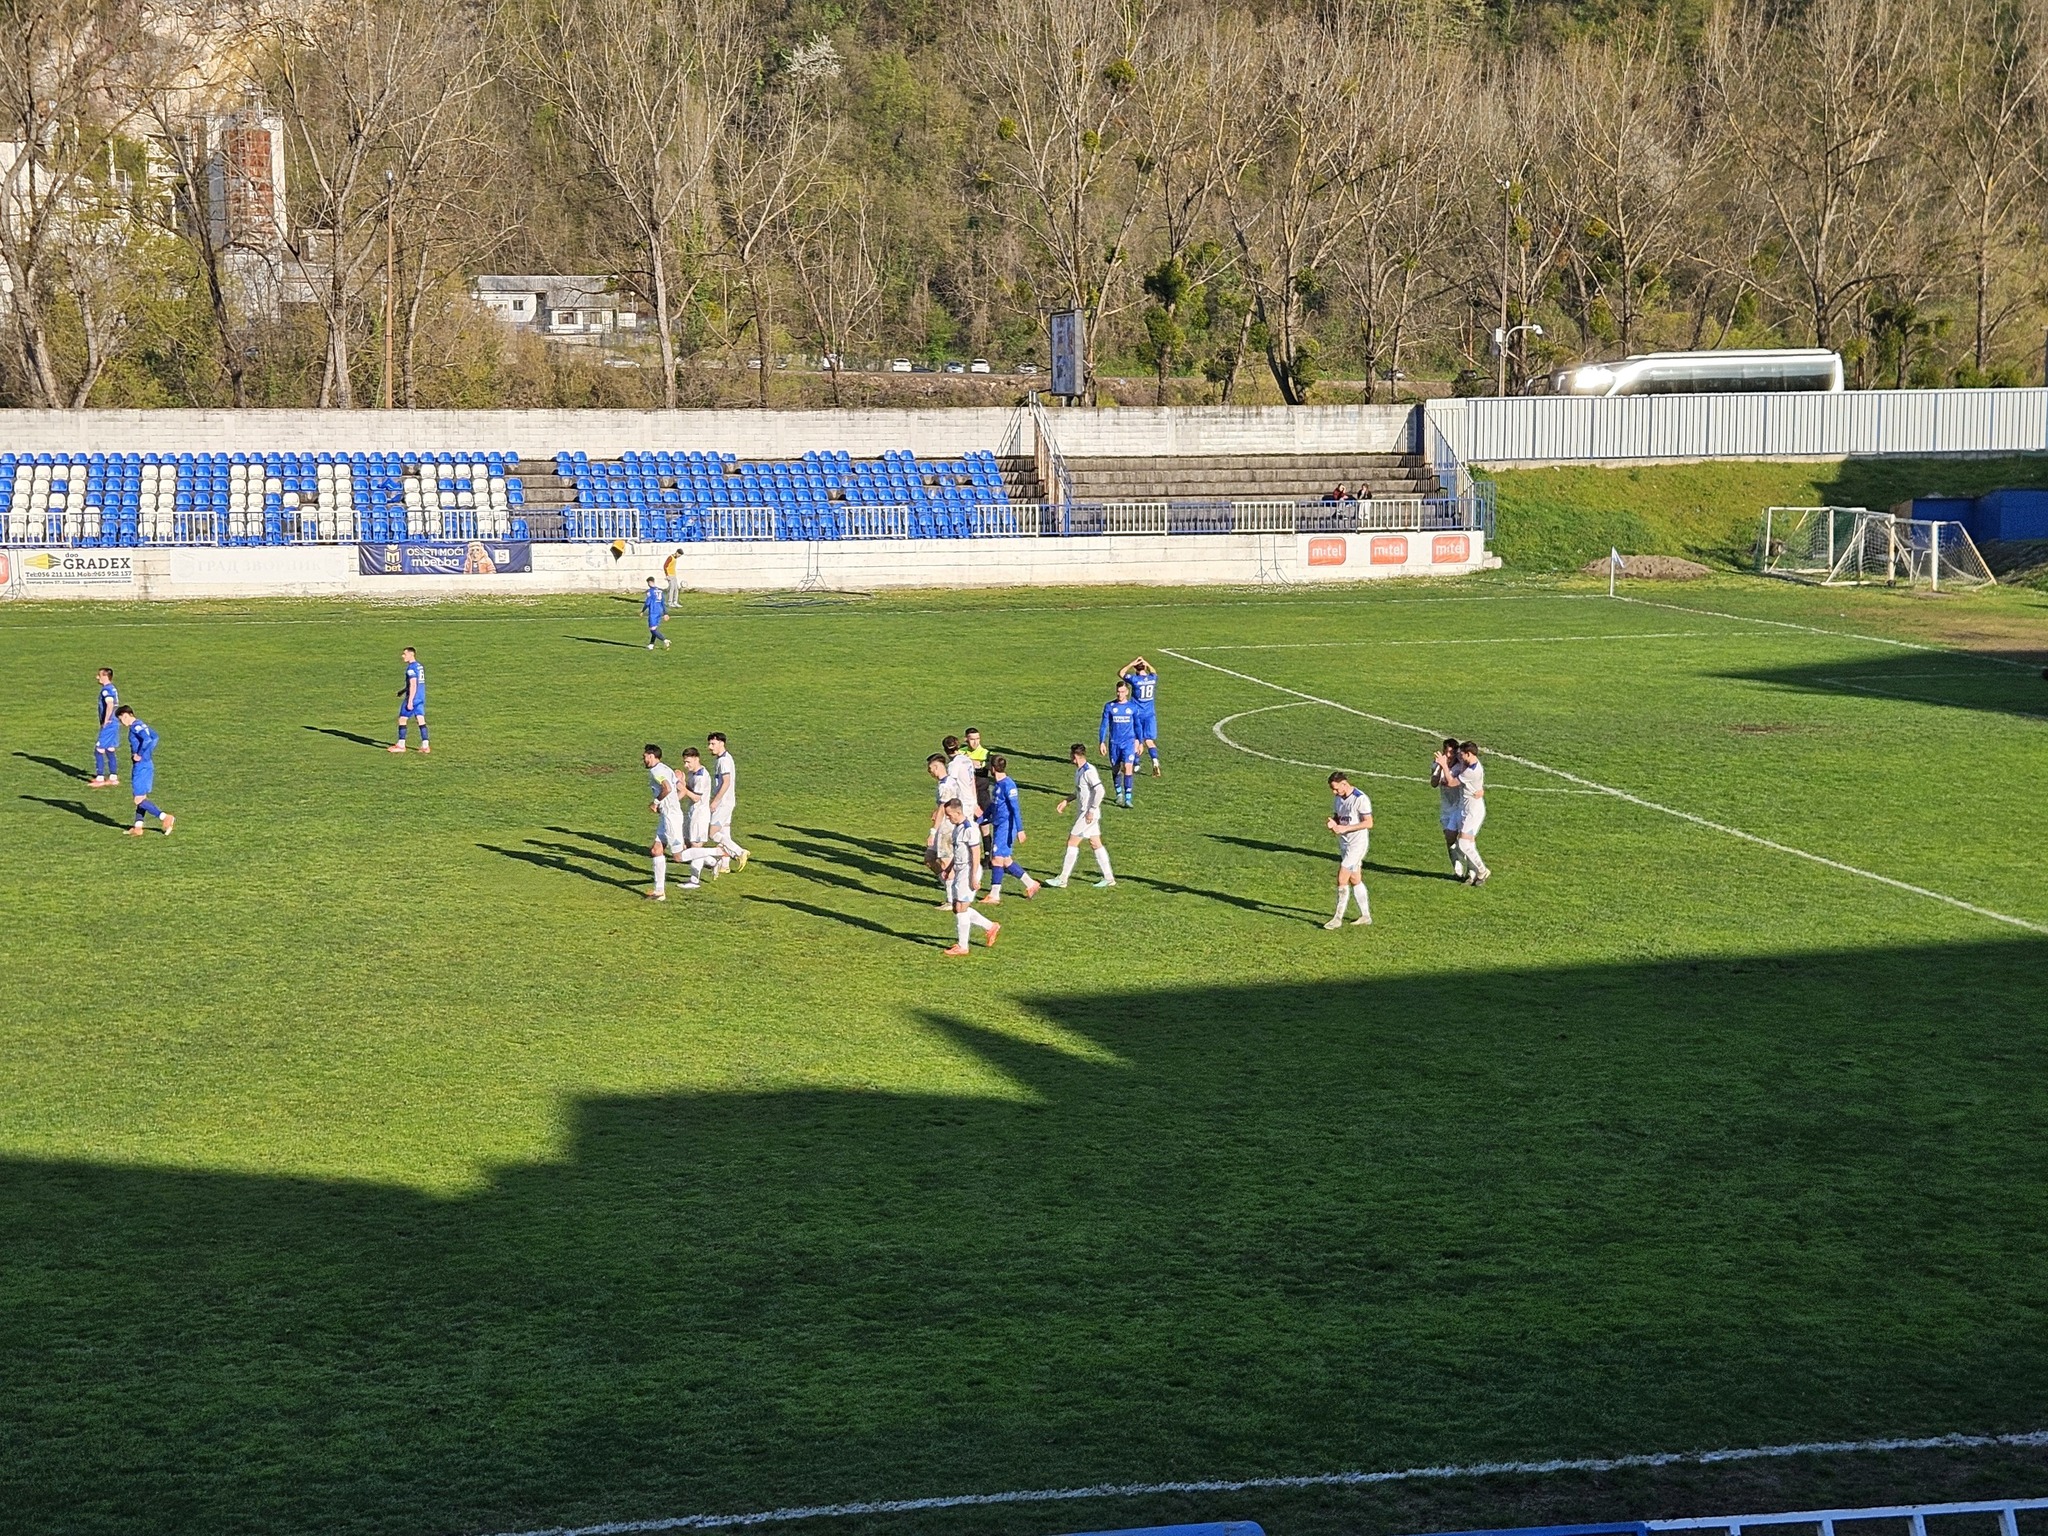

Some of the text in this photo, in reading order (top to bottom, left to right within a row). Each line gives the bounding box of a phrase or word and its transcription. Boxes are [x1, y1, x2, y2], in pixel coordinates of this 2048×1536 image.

[63, 558, 131, 570] GRADEX
[385, 564, 402, 572] bet
[1140, 685, 1154, 698] 18
